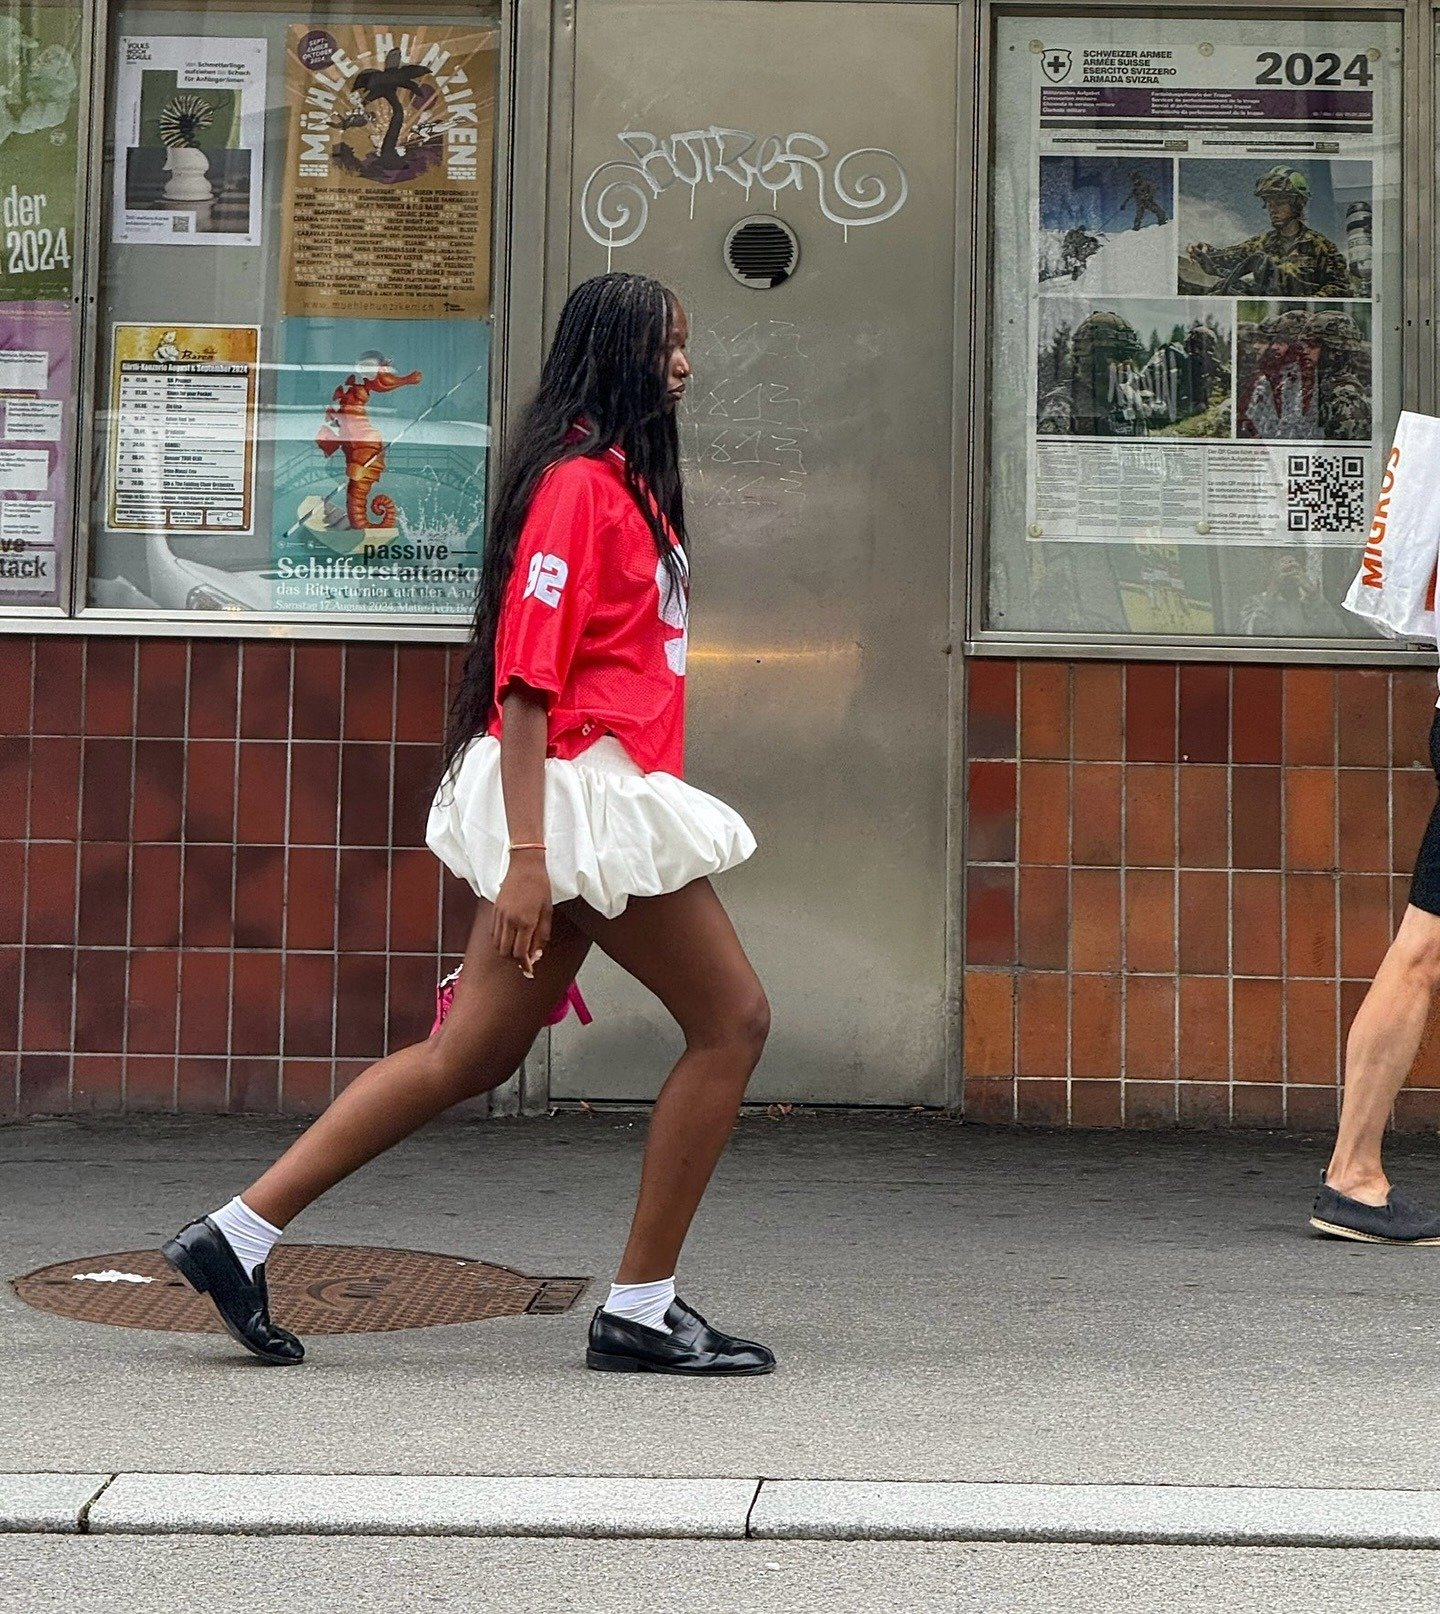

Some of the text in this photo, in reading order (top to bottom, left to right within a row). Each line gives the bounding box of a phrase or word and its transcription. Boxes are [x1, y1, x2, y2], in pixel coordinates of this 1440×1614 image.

[1083, 50, 1172, 59] SCHWEIZER ARMEE
[1083, 57, 1150, 67] ARMÉE SUISSE
[1083, 67, 1177, 76] ESERCITO SVIZZERO
[1255, 51, 1373, 87] 2024
[1083, 76, 1160, 84] ARMADA SVIZRA
[4, 184, 47, 228] der
[7, 226, 71, 274] 2024
[363, 540, 448, 565] passive
[523, 551, 568, 609] 92
[276, 582, 300, 595] das
[306, 583, 387, 597] Ritterturnier
[276, 600, 317, 612] Samstag
[333, 601, 366, 613] August
